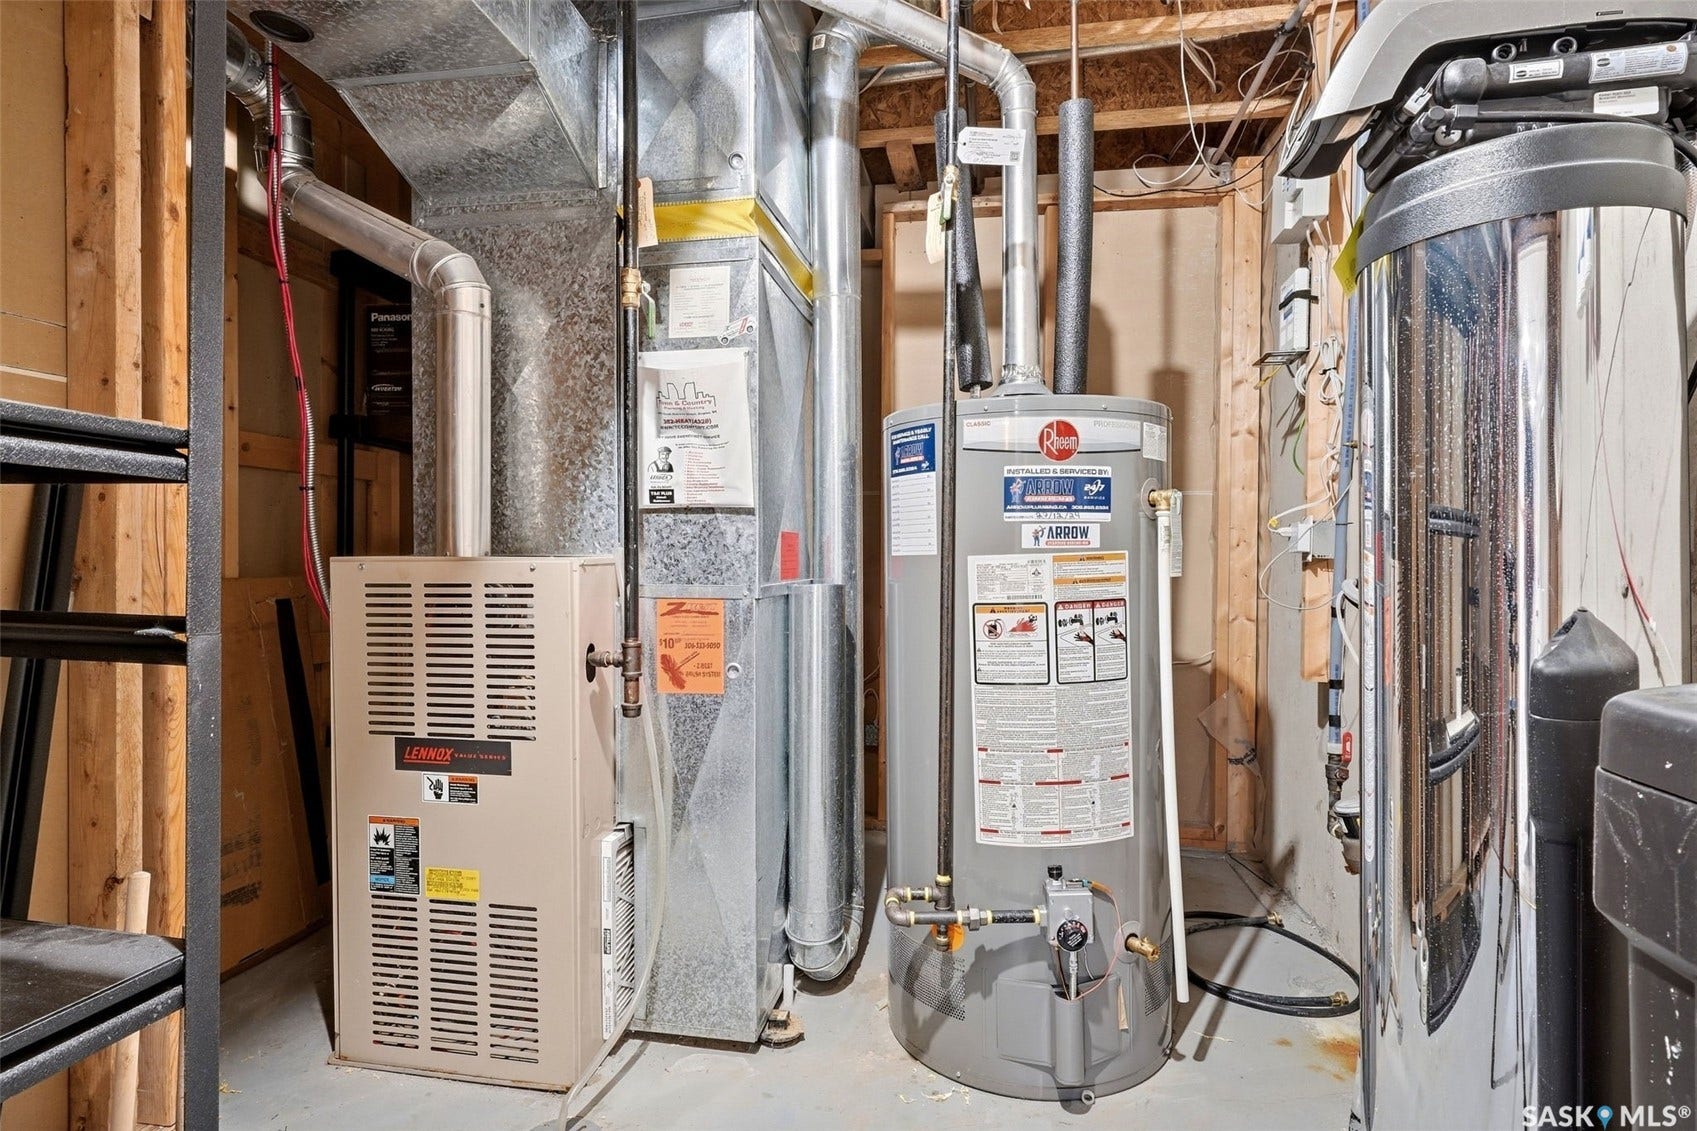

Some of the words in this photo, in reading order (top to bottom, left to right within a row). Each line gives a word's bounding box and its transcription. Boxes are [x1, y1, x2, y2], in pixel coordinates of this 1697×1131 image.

[1043, 421, 1078, 455] Rheem
[1026, 479, 1075, 495] ARROW
[1047, 526, 1090, 539] ARROW
[404, 746, 454, 761] LENNOX
